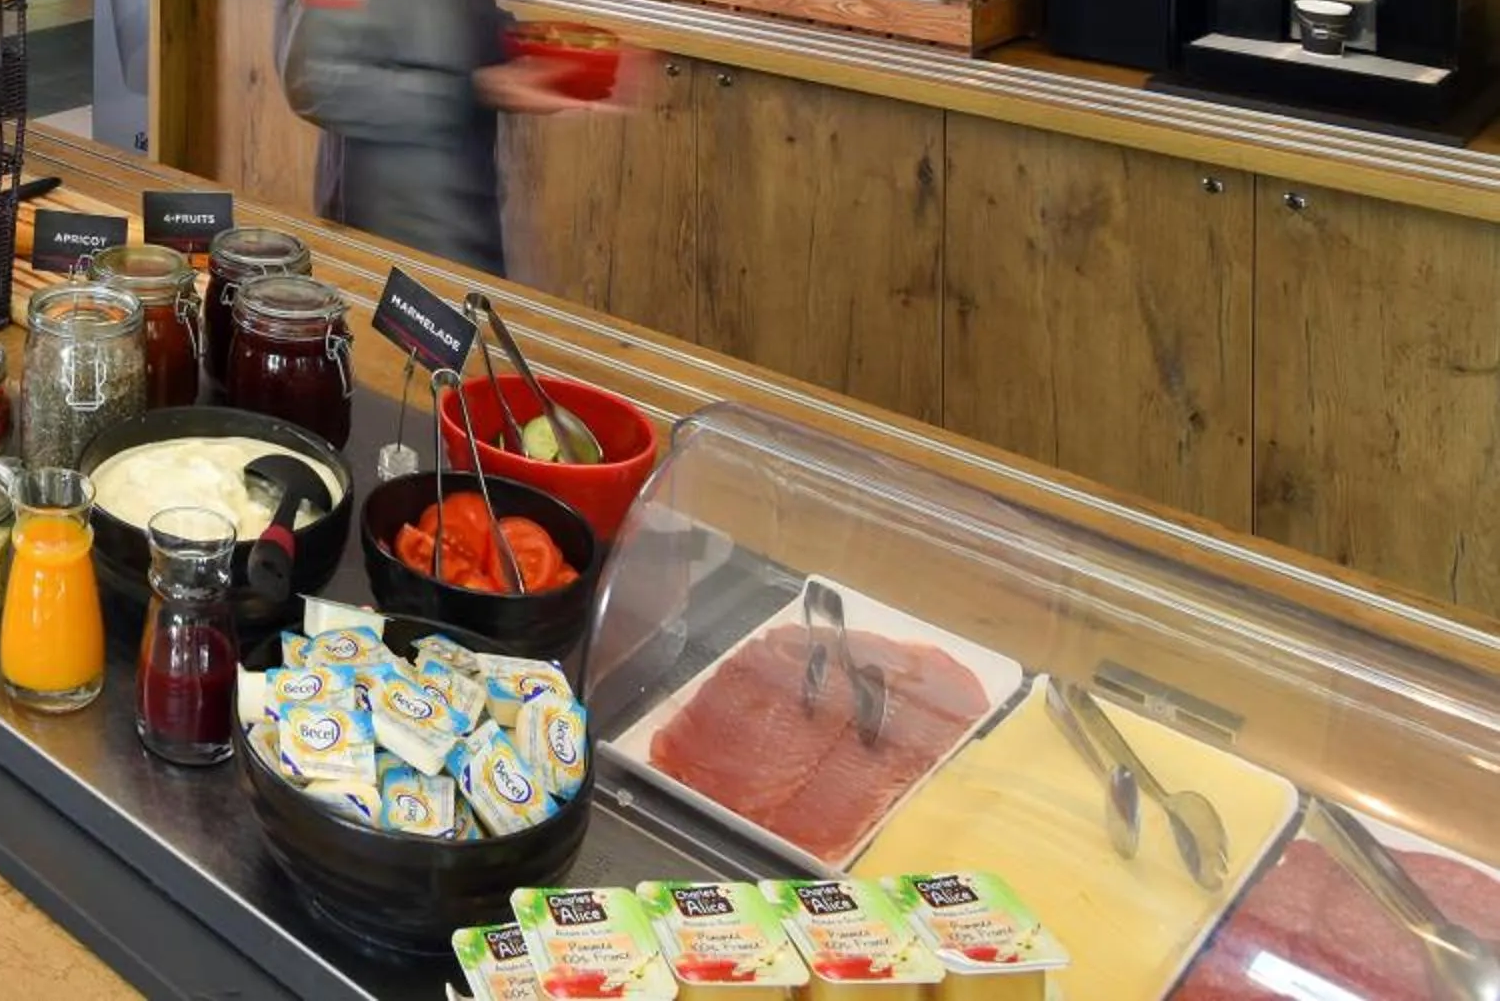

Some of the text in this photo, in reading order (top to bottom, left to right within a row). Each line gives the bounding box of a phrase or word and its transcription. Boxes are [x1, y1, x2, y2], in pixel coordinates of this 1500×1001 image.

[163, 213, 216, 224] 4-FRUITS
[53, 231, 108, 248] APRICOT
[390, 294, 461, 352] MARMELADE
[283, 681, 318, 694] Becel
[393, 691, 427, 718] Becel
[300, 724, 335, 741] Becel
[555, 717, 571, 762] Becel
[494, 758, 525, 799] Becel
[798, 885, 839, 899] Charles
[917, 878, 958, 891] Charles
[549, 893, 592, 908] Charles
[675, 888, 717, 900] Charles
[931, 891, 972, 905] Alice
[687, 899, 728, 915] Alice
[811, 897, 851, 913] Alice
[560, 906, 601, 925] Alice
